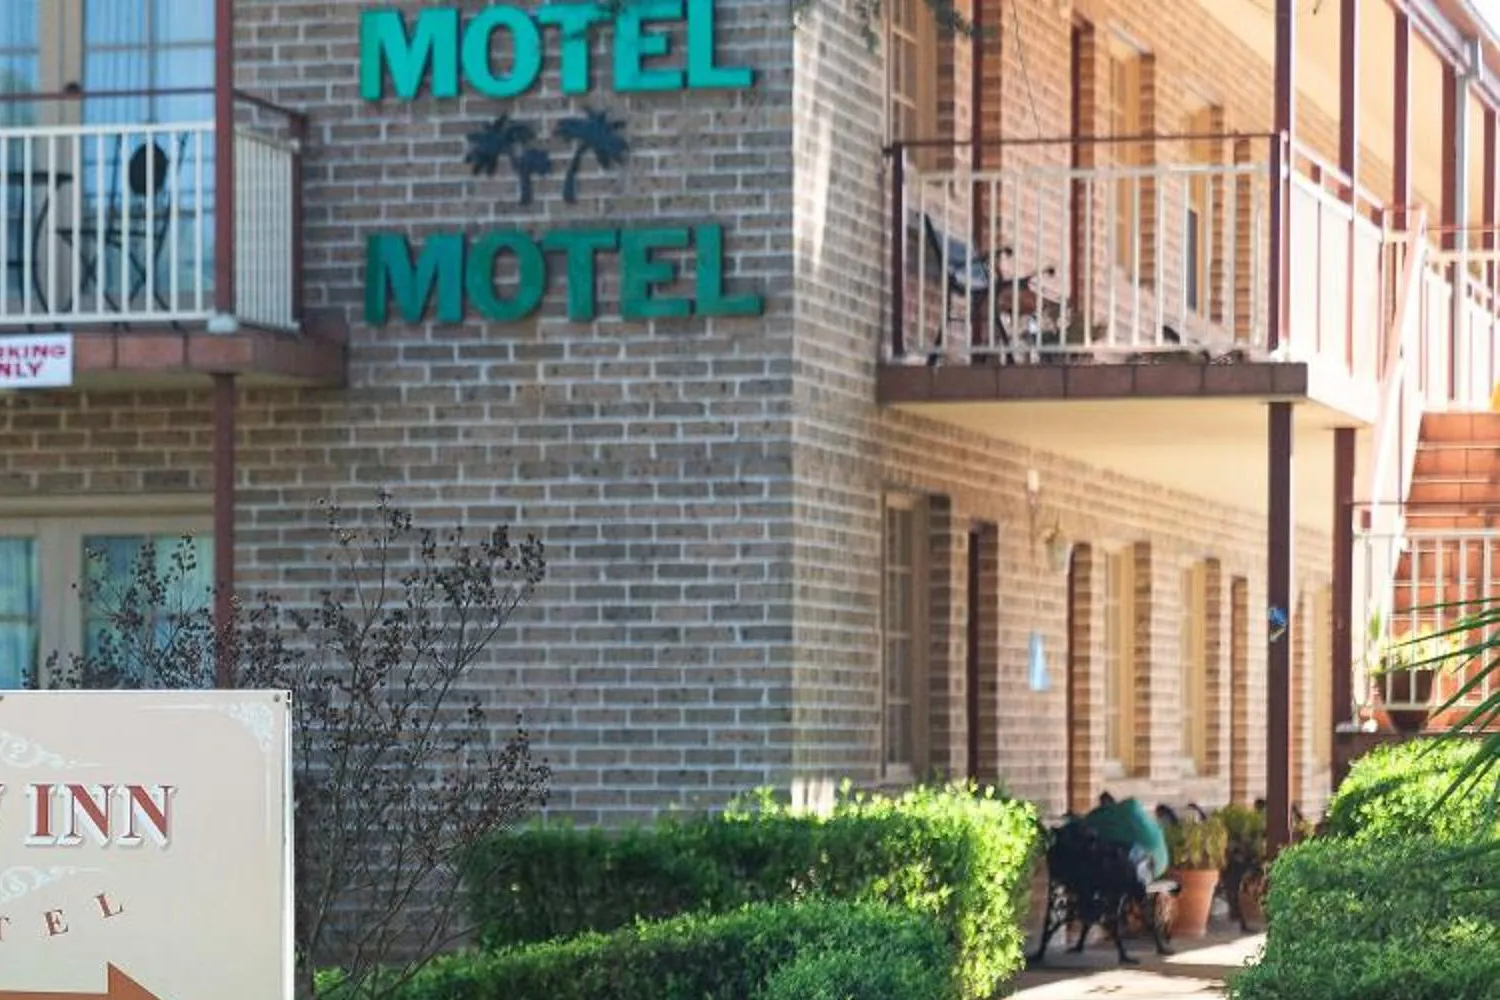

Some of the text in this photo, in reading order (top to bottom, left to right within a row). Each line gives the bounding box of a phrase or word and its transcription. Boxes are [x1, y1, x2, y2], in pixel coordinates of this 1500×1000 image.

[360, 0, 754, 101] MOTEL
[365, 223, 765, 326] MOTEL
[23, 783, 179, 848] INN
